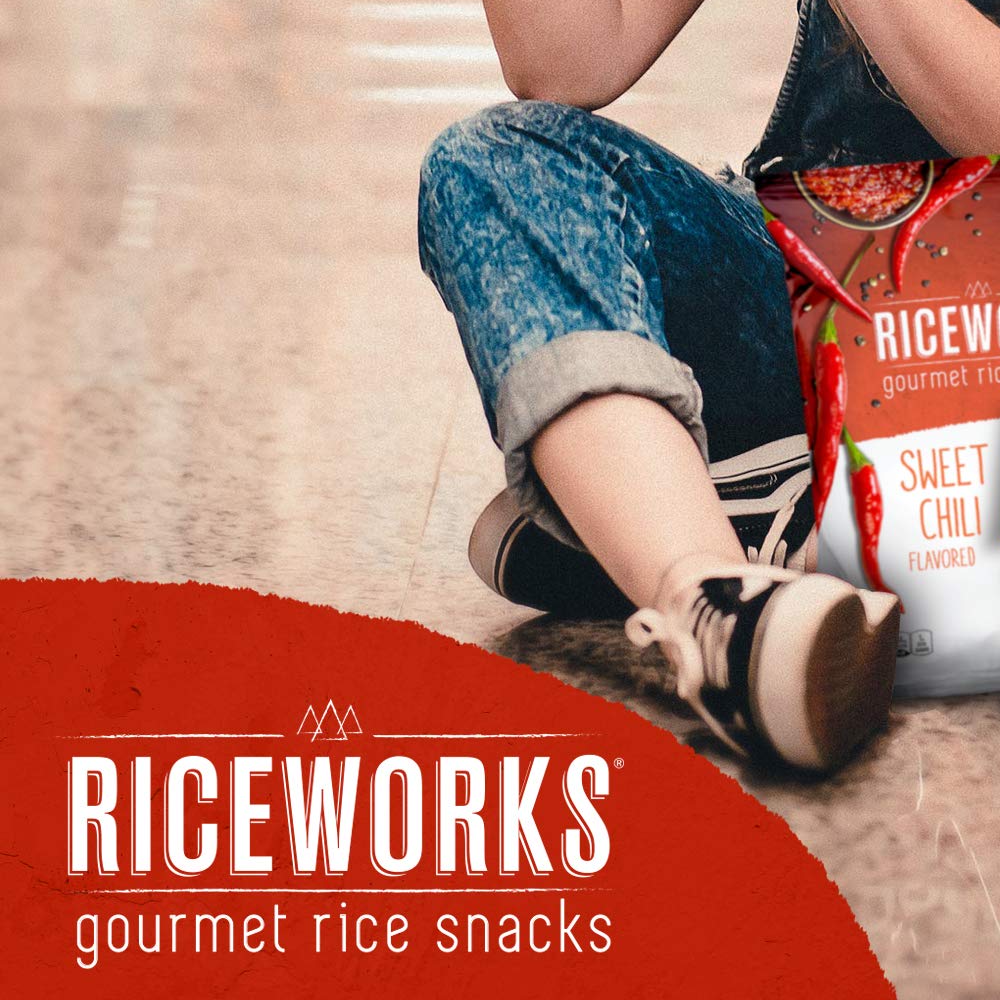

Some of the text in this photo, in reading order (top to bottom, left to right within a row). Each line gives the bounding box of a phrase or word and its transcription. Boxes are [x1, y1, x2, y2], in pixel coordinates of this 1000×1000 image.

[882, 363, 969, 399] gourmet
[900, 444, 988, 492] SWEET
[919, 496, 982, 540] CHILI
[908, 546, 976, 572] FLAVORED
